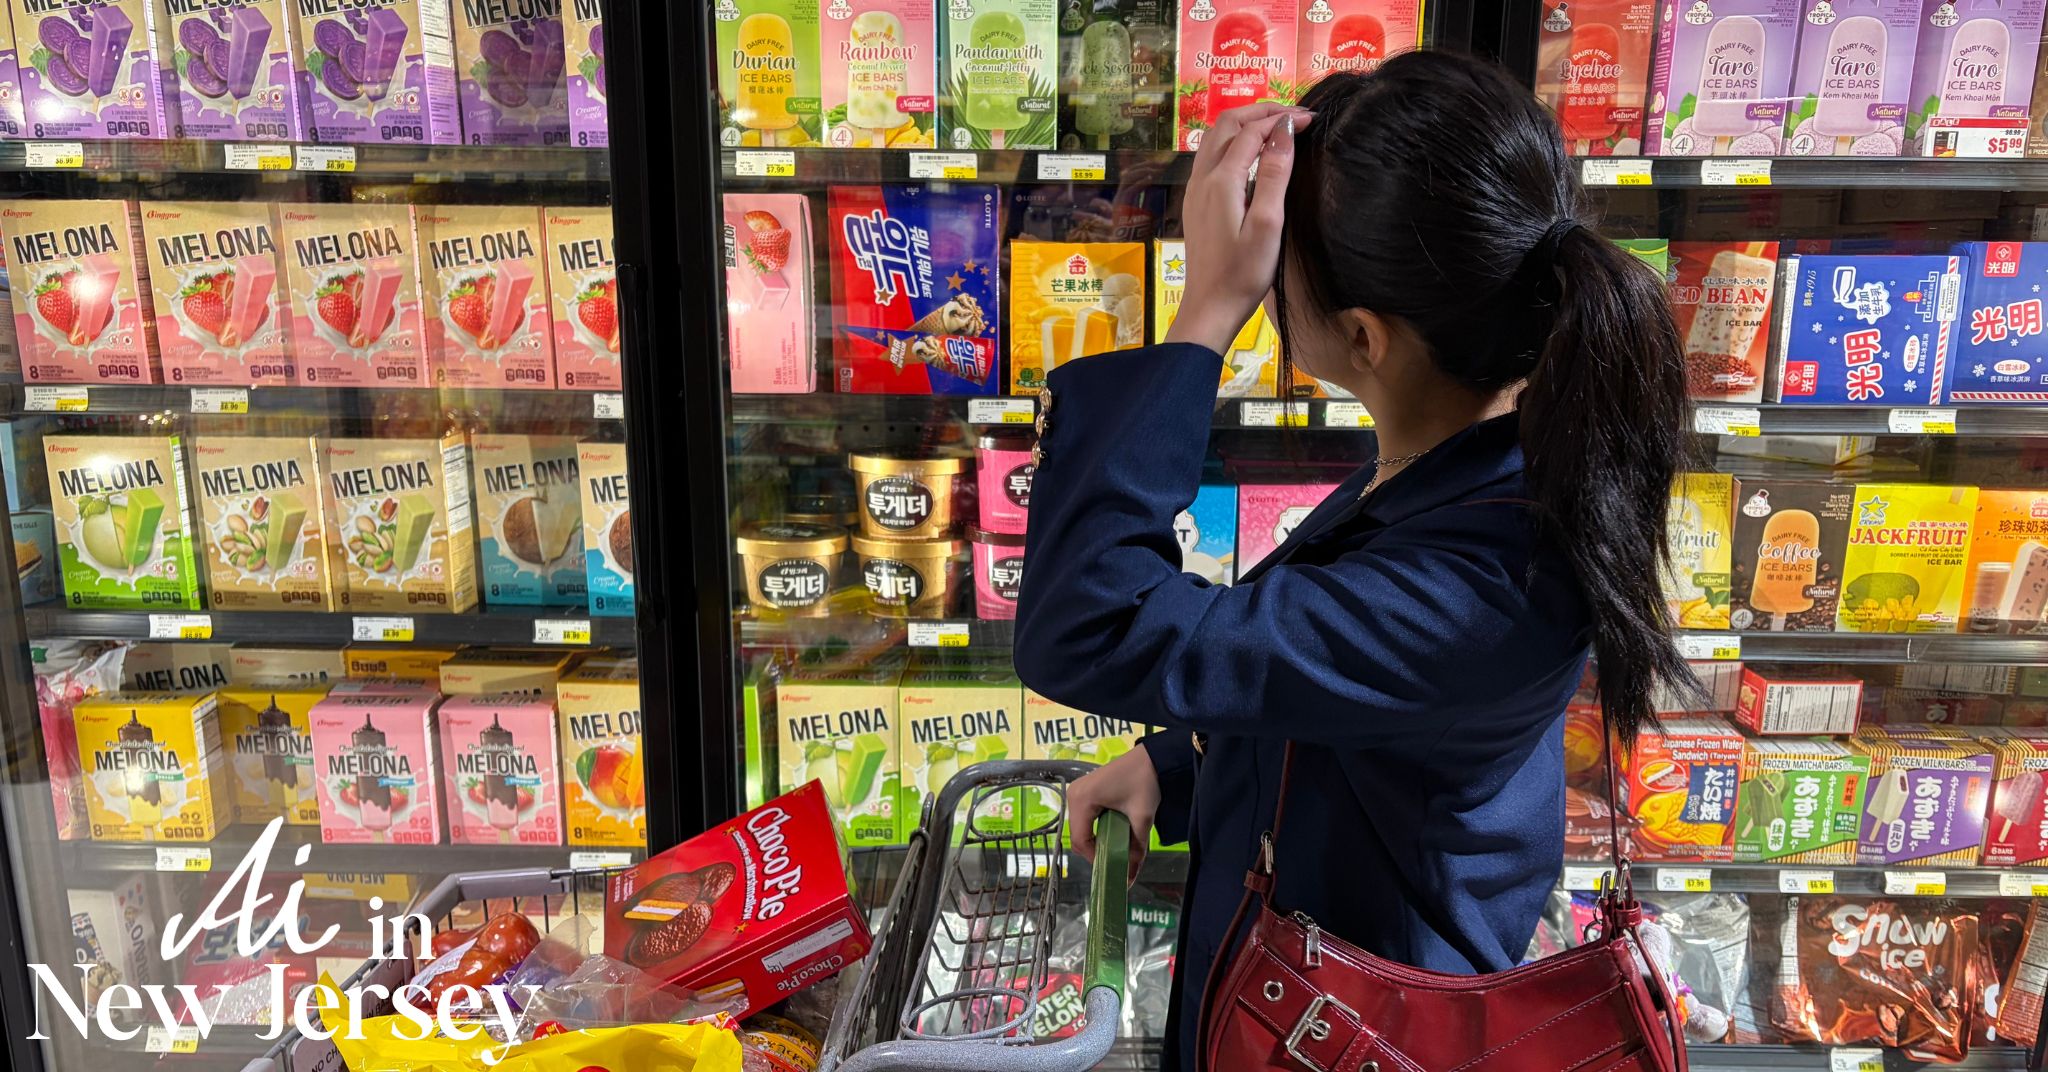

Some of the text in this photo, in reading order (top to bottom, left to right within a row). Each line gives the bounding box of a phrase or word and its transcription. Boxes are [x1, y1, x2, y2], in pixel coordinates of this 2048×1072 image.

[747, 39, 784, 50] DAIRY FREE
[858, 32, 896, 43] DAIRY FREE
[980, 31, 1018, 43] DAIRY FREE
[1220, 39, 1260, 51] DAIRY FREE
[840, 41, 917, 61] Rainbow
[956, 44, 1043, 60] Pandan with
[1337, 40, 1377, 53] DAIRY FREE
[1714, 43, 1754, 55] DAIRY FREE
[1837, 43, 1877, 55] DAIRY FREE
[1959, 45, 2000, 58] DAIRY FREE
[733, 50, 797, 70] Durian
[1195, 52, 1284, 74] Strawberry
[1573, 49, 1612, 62] DAIRY FREE
[965, 62, 1003, 73] Coconut
[1103, 60, 1153, 75] Sesame
[1560, 59, 1622, 84] Lychee
[1708, 55, 1756, 75] Taro
[1831, 56, 1877, 76] Taro
[1953, 58, 1999, 78] Taro
[740, 73, 792, 83] ICE BARS
[852, 73, 904, 82] ICE BARS
[972, 76, 1025, 85] ICE BARS
[1082, 80, 1129, 88] ICE BARS
[1211, 74, 1265, 85] ICE BARS
[1704, 79, 1757, 89] ICE BARS
[1825, 79, 1880, 89] ICE BARS
[1948, 81, 2002, 91] ICE BARS
[1563, 84, 1616, 93] ICE BARS
[789, 100, 819, 110] Natural
[901, 99, 930, 109] Natural
[1021, 100, 1051, 109] Natural
[1126, 106, 1153, 115] Natural
[1750, 106, 1781, 116] Natural
[1872, 107, 1902, 117] Natural
[1993, 108, 2024, 117] Natural
[1609, 110, 1639, 120] Natural
[766, 166, 785, 174] $7.99
[13, 224, 118, 264] MELONA
[158, 225, 275, 266] MELONA
[295, 227, 402, 267] MELONA
[429, 230, 535, 269] MELONA
[1986, 261, 2016, 274] 光明
[1051, 278, 1103, 293] 芒果冰棒
[1707, 288, 1768, 304] BEAN
[1858, 290, 1870, 315] 添加
[1971, 300, 2042, 345] 光明
[1844, 329, 1884, 400] 光明
[1801, 364, 1815, 392] 光明
[59, 459, 164, 496] MELONA
[202, 460, 305, 496] MELONA
[331, 461, 433, 499] MELONA
[485, 458, 579, 493] MELONA
[869, 495, 926, 516] 투게더
[1772, 533, 1810, 543] DAIRY FREE
[1850, 528, 1967, 546] JACKFRUIT
[1758, 544, 1820, 562] Coffee
[1761, 563, 1812, 572] ICE BARS
[764, 573, 824, 598] 투게더
[864, 571, 917, 598] 투게더
[1806, 587, 1836, 596] Natural
[136, 665, 227, 691] MELONA
[788, 707, 889, 741] MELONA
[911, 709, 1012, 743] MELONA
[1034, 715, 1133, 745] MELONA
[237, 733, 313, 754] MELONA
[1662, 739, 1743, 749] Japanese Frozen Wafer
[96, 751, 180, 770] MELONA
[458, 753, 537, 774] MELONA
[1673, 751, 1708, 760] Sandwich
[1890, 757, 1965, 768] FROZEN MILK BARS
[329, 755, 410, 775] MELONA
[1763, 760, 1789, 768] FROZEN
[1793, 761, 1821, 769] MATCHA
[1700, 767, 1724, 820] たい焼
[1790, 776, 1820, 838] あずき
[1910, 776, 1942, 840] あずき
[1890, 823, 1902, 848] ミルク
[747, 807, 802, 921] Choco Pie
[1131, 907, 1170, 924] Multi
[1828, 905, 1947, 957] Snow
[1881, 944, 1925, 970] ice
[777, 954, 844, 991] Choco Pie
